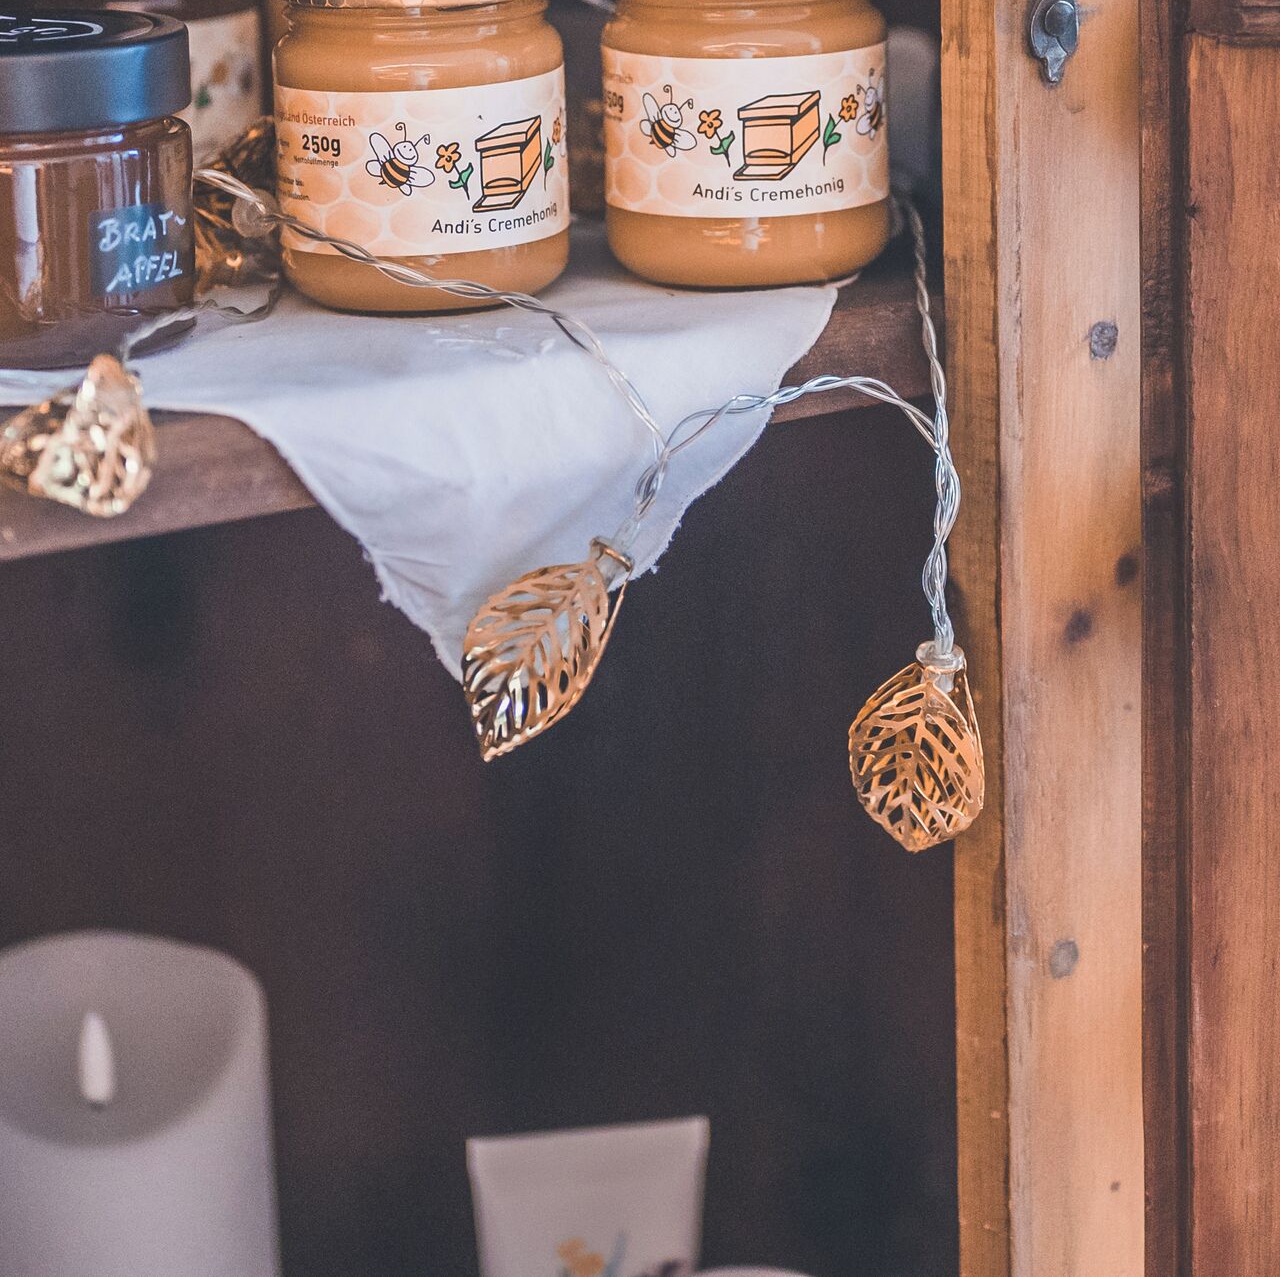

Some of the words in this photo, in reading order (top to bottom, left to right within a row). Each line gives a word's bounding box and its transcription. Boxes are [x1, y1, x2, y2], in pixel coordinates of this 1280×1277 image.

[302, 111, 356, 127] Österreich
[301, 134, 341, 158] 250g
[749, 177, 846, 202] Cremehonig
[487, 201, 559, 233] Cremehonig
[105, 249, 183, 293] APFEL
